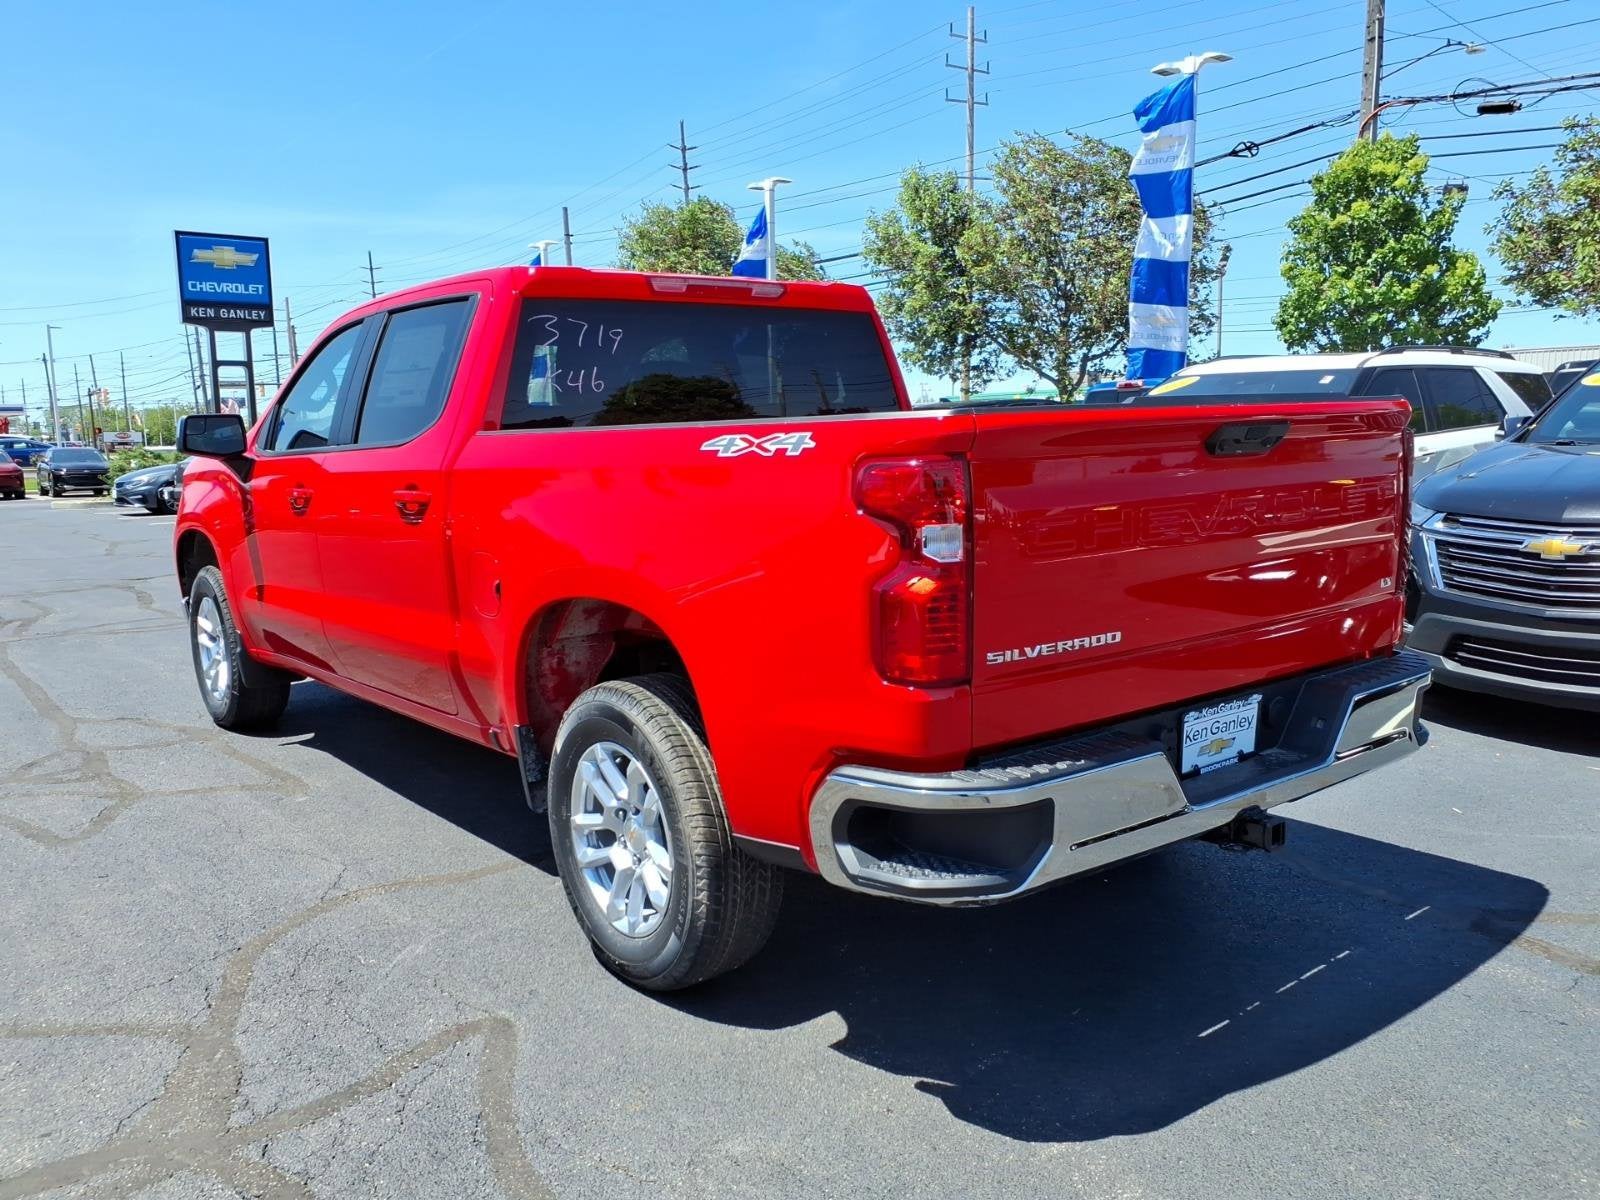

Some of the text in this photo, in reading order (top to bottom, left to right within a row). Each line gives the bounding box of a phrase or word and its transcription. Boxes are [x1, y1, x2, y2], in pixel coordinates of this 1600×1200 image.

[187, 280, 265, 295] CHEVROLET
[190, 306, 266, 320] KEN GANLEY
[527, 314, 623, 355] 3719
[986, 631, 1121, 665] SILVERADO
[1184, 713, 1255, 745] Ken Ganley
